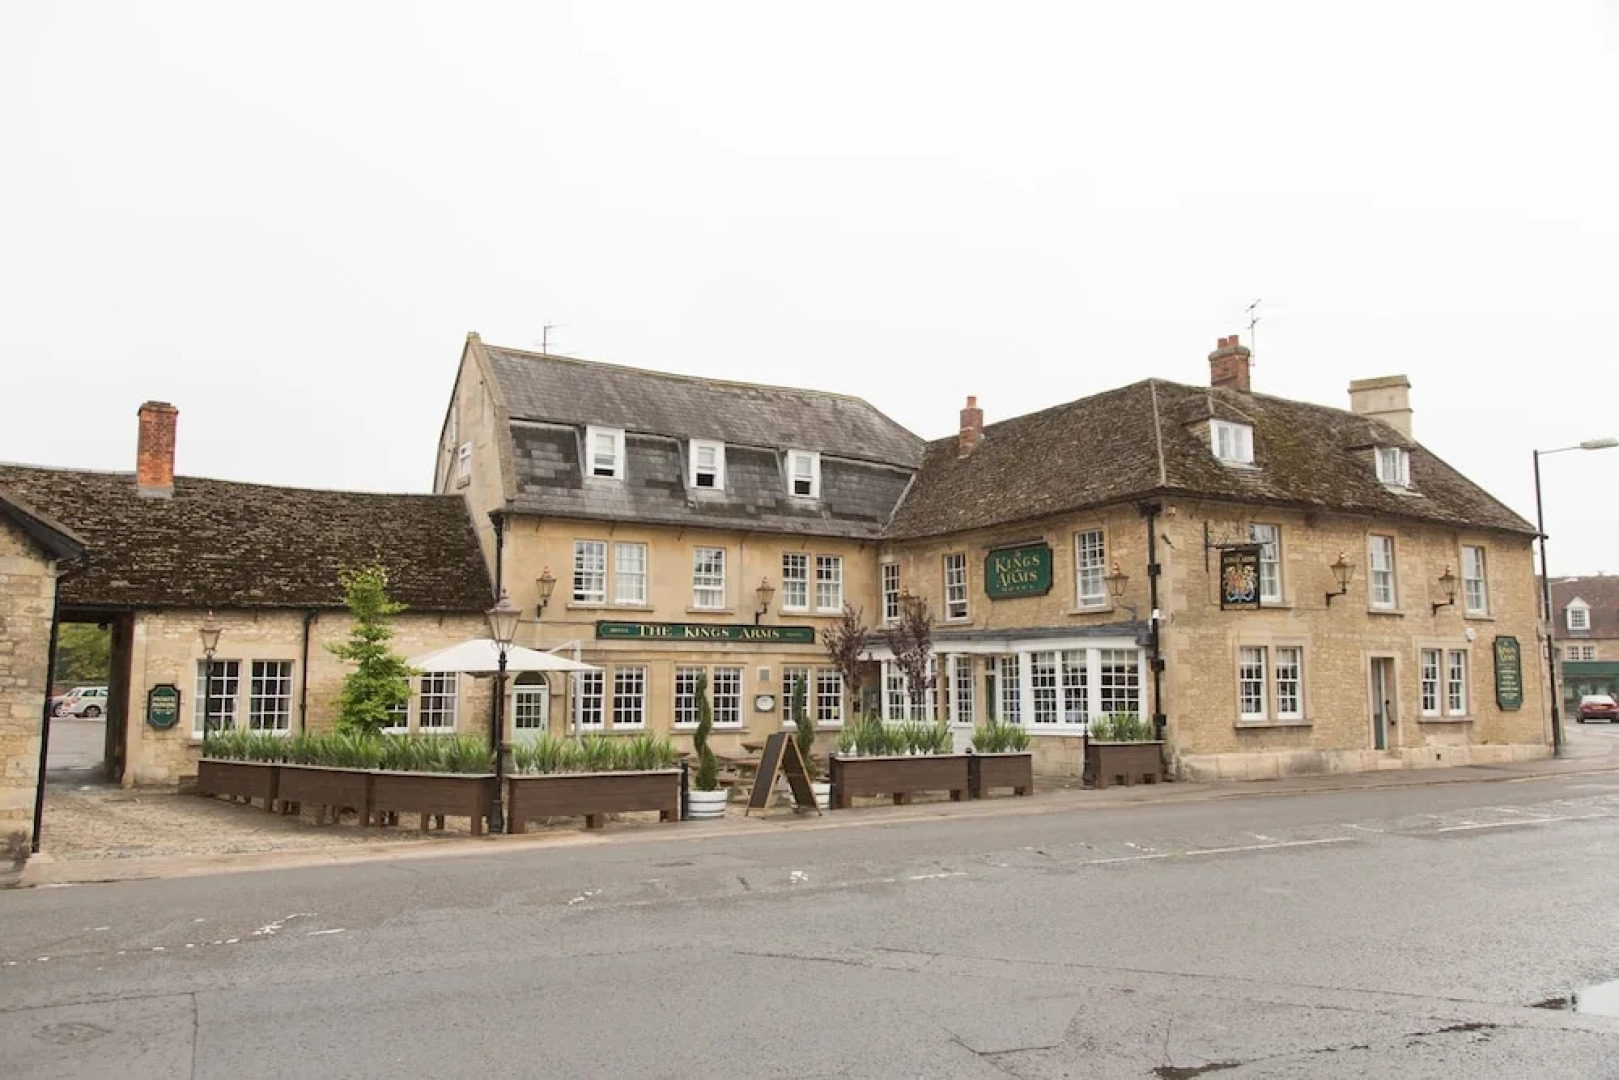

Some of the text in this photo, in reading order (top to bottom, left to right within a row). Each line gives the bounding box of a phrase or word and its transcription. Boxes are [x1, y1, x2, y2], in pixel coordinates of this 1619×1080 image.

[995, 556, 1040, 573] KINGS
[999, 571, 1037, 587] ARMS
[636, 624, 673, 637] THE
[684, 625, 730, 638] KINGS
[738, 627, 780, 639] ARMS
